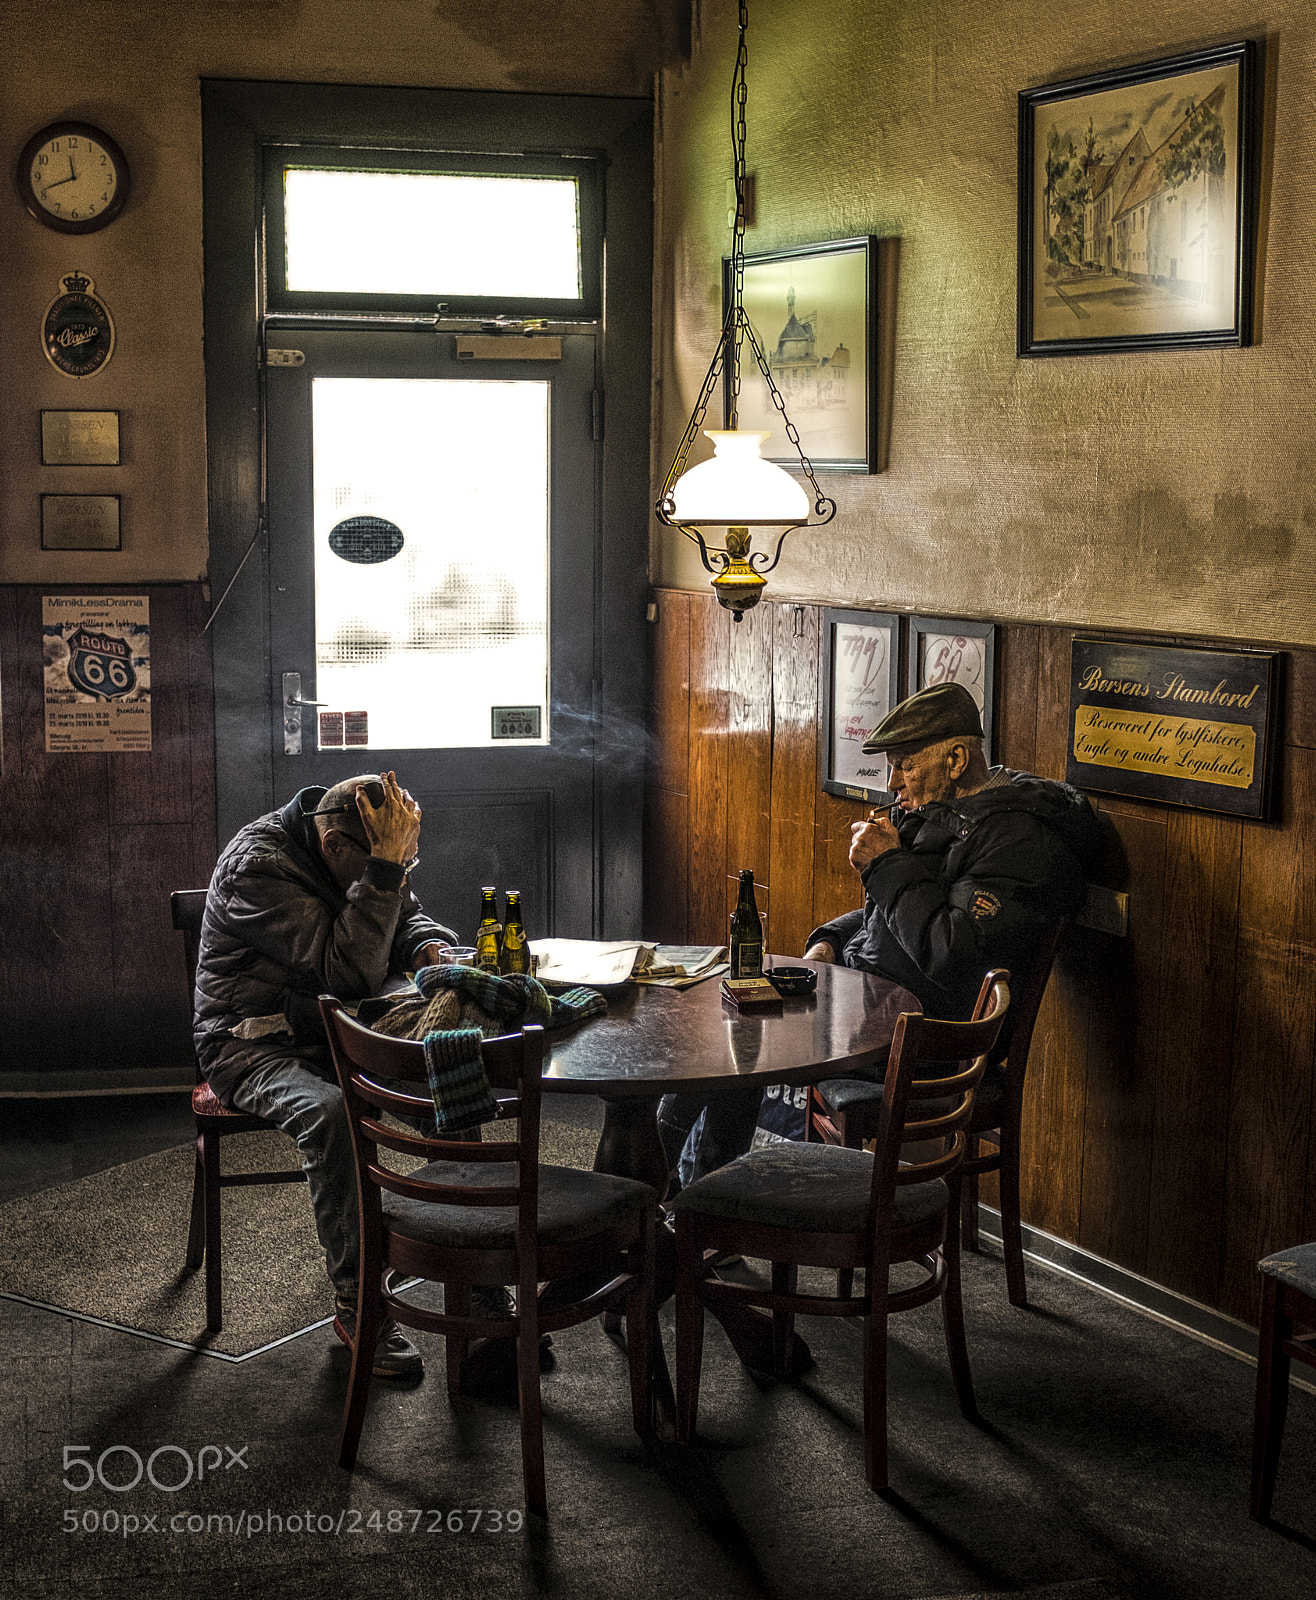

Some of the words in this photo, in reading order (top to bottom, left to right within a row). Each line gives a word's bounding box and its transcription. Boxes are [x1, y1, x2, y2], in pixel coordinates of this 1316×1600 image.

[51, 141, 61, 153] 11
[68, 137, 78, 149] 12
[88, 142, 93, 153] 1
[38, 154, 49, 166] 10
[100, 154, 107, 166] 2
[34, 172, 42, 181] 9
[106, 173, 114, 185] 3
[101, 191, 108, 202] 4
[54, 202, 61, 214] 7
[71, 208, 79, 219] 6
[89, 204, 96, 215] 5
[57, 326, 99, 347] Classic
[48, 598, 143, 607] MimikLessDrama
[80, 635, 126, 655] ROUTE
[83, 655, 128, 688] 66
[1156, 671, 1260, 709] Stambord
[1083, 710, 1152, 735] Reserveret
[1148, 718, 1172, 742] for
[1175, 722, 1246, 750] lystfiskere,
[1076, 732, 1110, 760] Engle
[1114, 747, 1129, 763] og
[1133, 747, 1171, 765] andre
